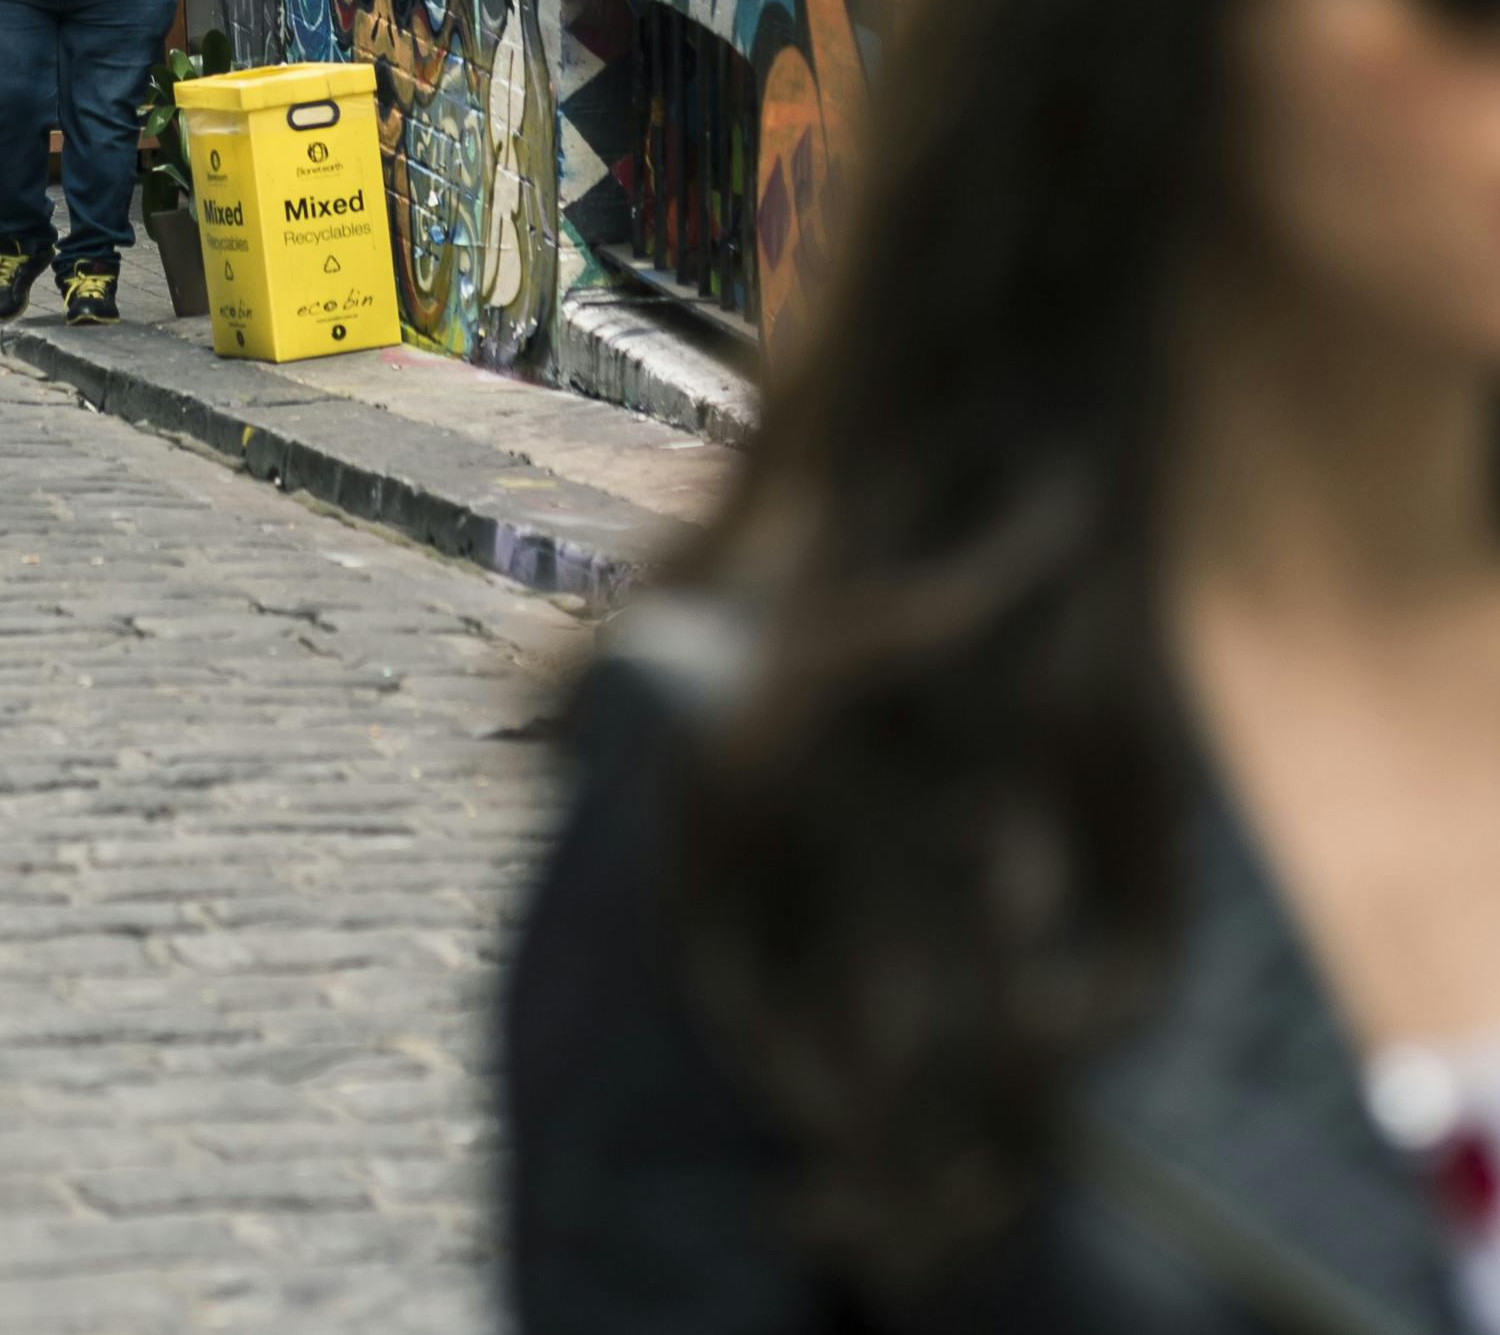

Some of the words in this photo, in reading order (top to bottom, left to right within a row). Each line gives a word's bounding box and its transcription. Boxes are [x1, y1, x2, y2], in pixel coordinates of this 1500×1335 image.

[203, 198, 244, 226] Mixed
[284, 189, 365, 222] Mixed
[283, 223, 372, 247] Recyclables
